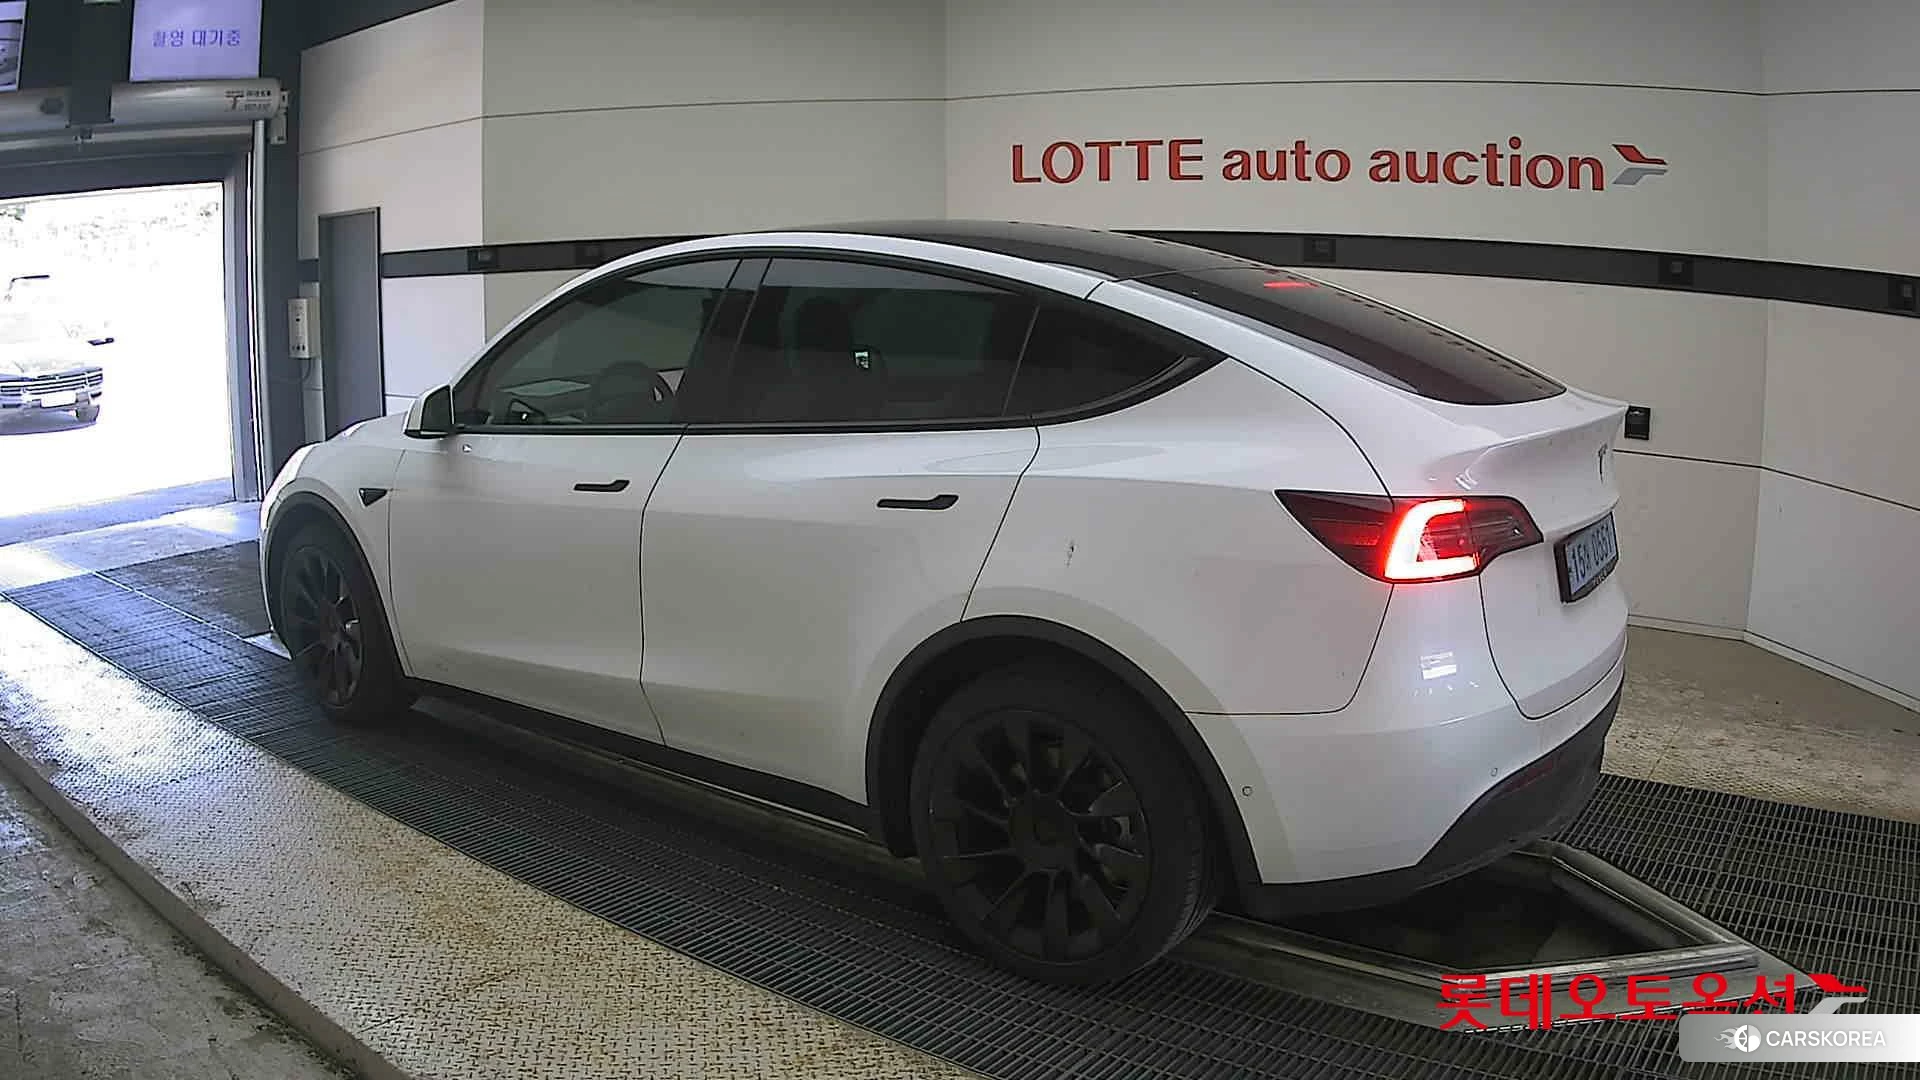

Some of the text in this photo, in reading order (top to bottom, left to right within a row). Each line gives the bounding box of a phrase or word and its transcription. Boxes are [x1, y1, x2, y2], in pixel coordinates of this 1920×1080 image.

[1011, 136, 1604, 191] LOTTE auto auction
